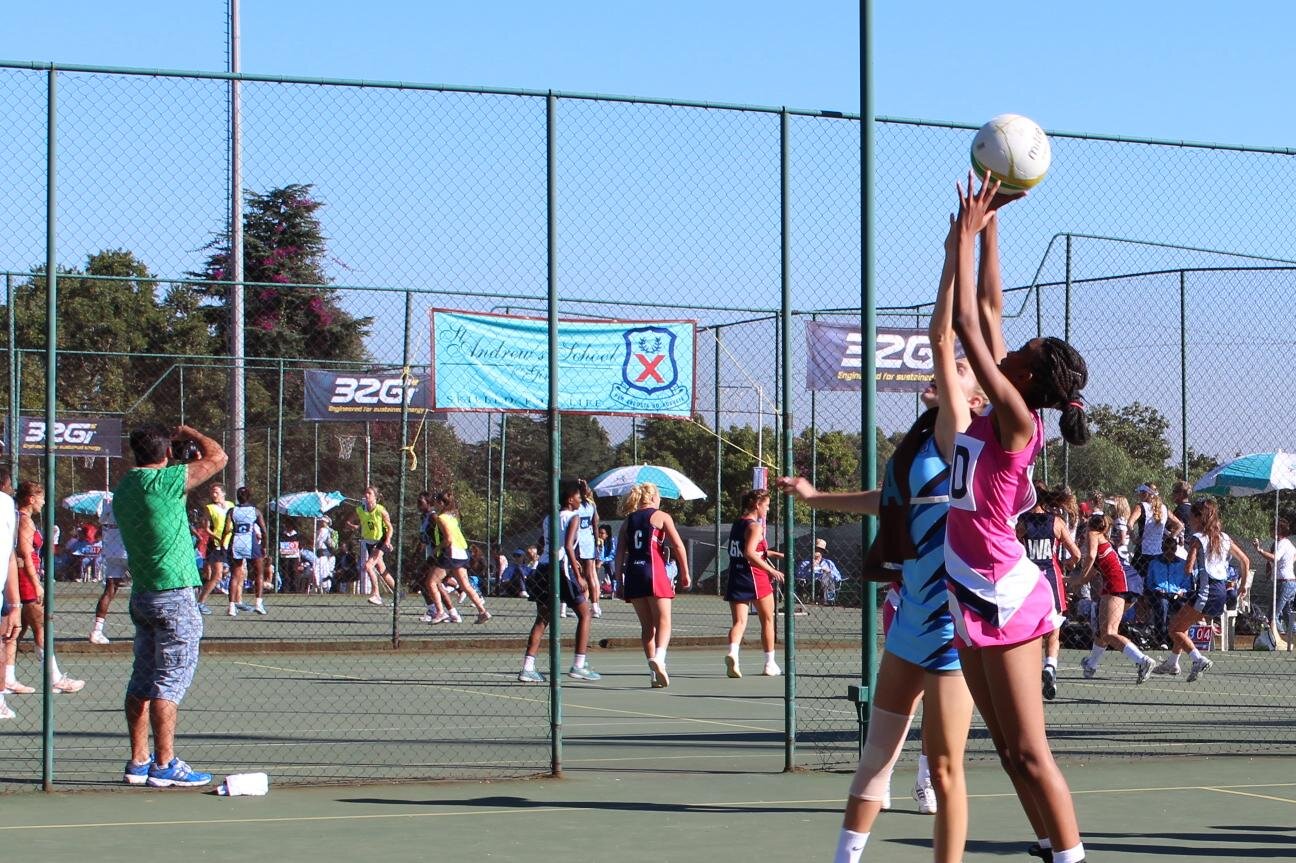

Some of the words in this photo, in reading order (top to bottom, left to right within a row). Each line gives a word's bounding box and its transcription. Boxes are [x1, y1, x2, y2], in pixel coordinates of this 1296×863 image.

[841, 332, 935, 369] 32G
[882, 373, 895, 381] for
[330, 377, 419, 406] 32Gi
[951, 445, 970, 499] D
[634, 530, 642, 549] C
[1028, 538, 1053, 560] WA
